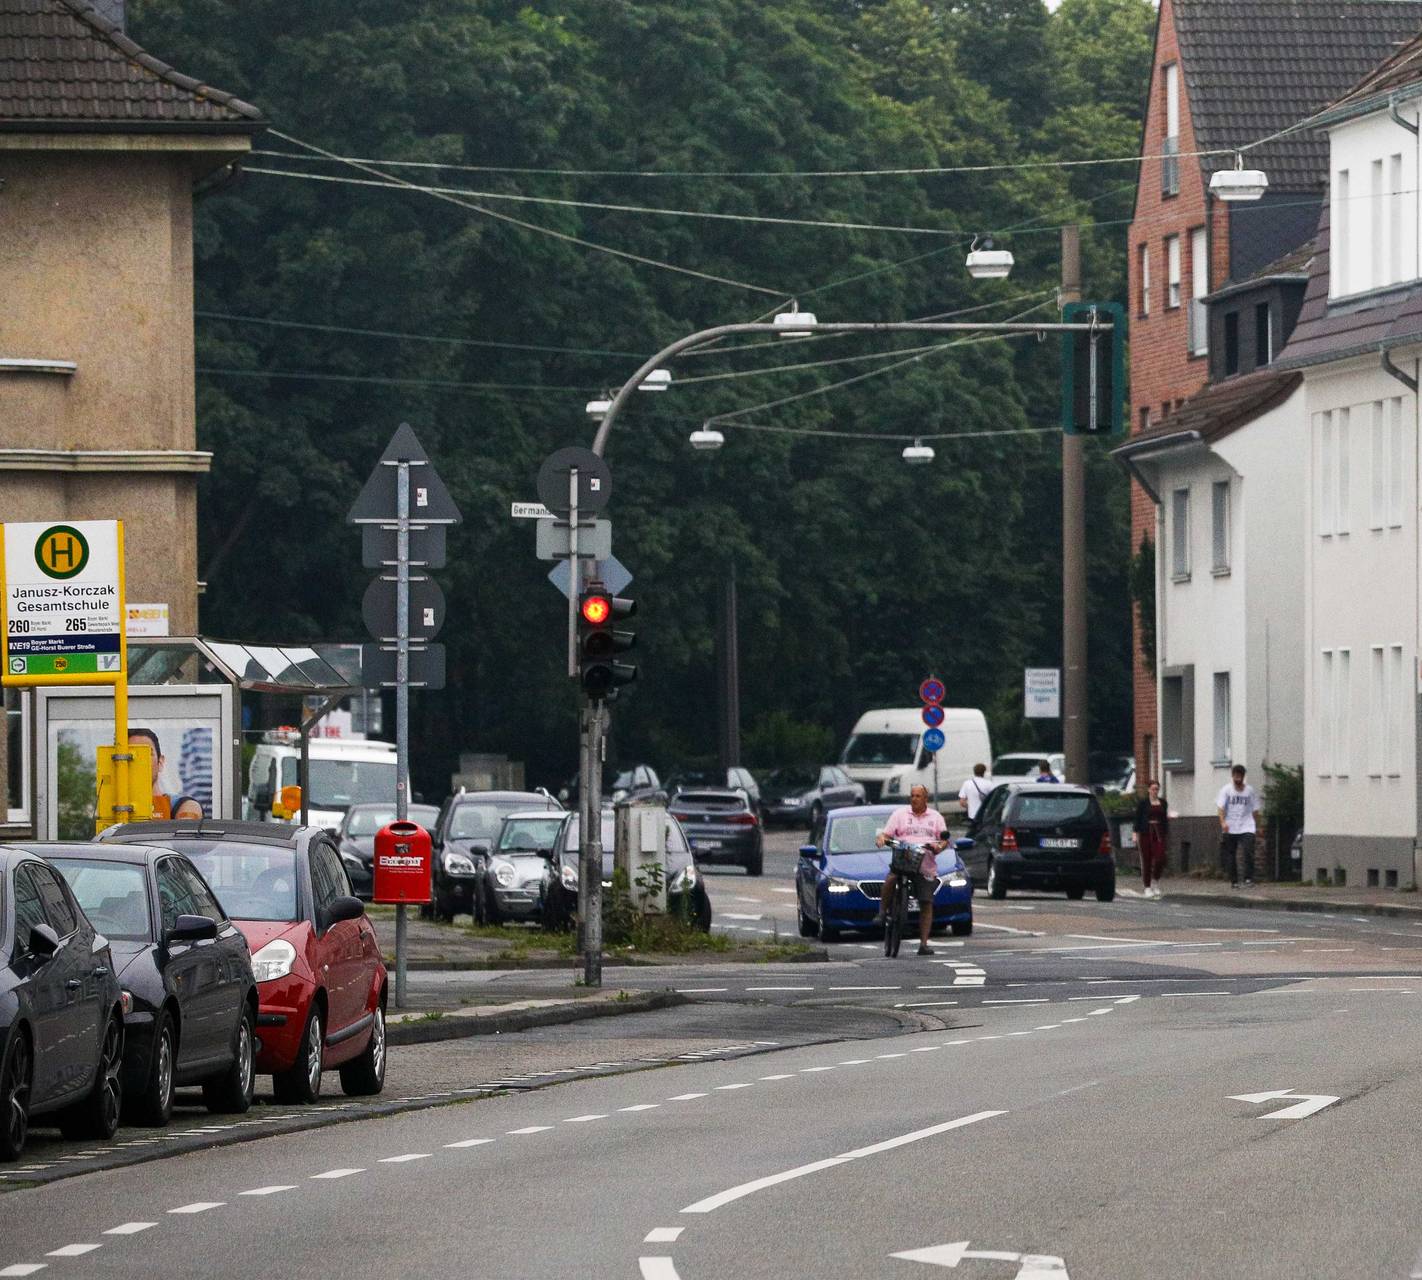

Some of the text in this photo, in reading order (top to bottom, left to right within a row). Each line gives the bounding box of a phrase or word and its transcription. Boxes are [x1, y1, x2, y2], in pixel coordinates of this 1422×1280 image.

[513, 505, 546, 515] German
[50, 537, 73, 568] H
[12, 584, 115, 598] Janusz-Korczak
[17, 600, 110, 612] Gesamtschule
[9, 619, 30, 633] 260
[65, 618, 87, 632] 265
